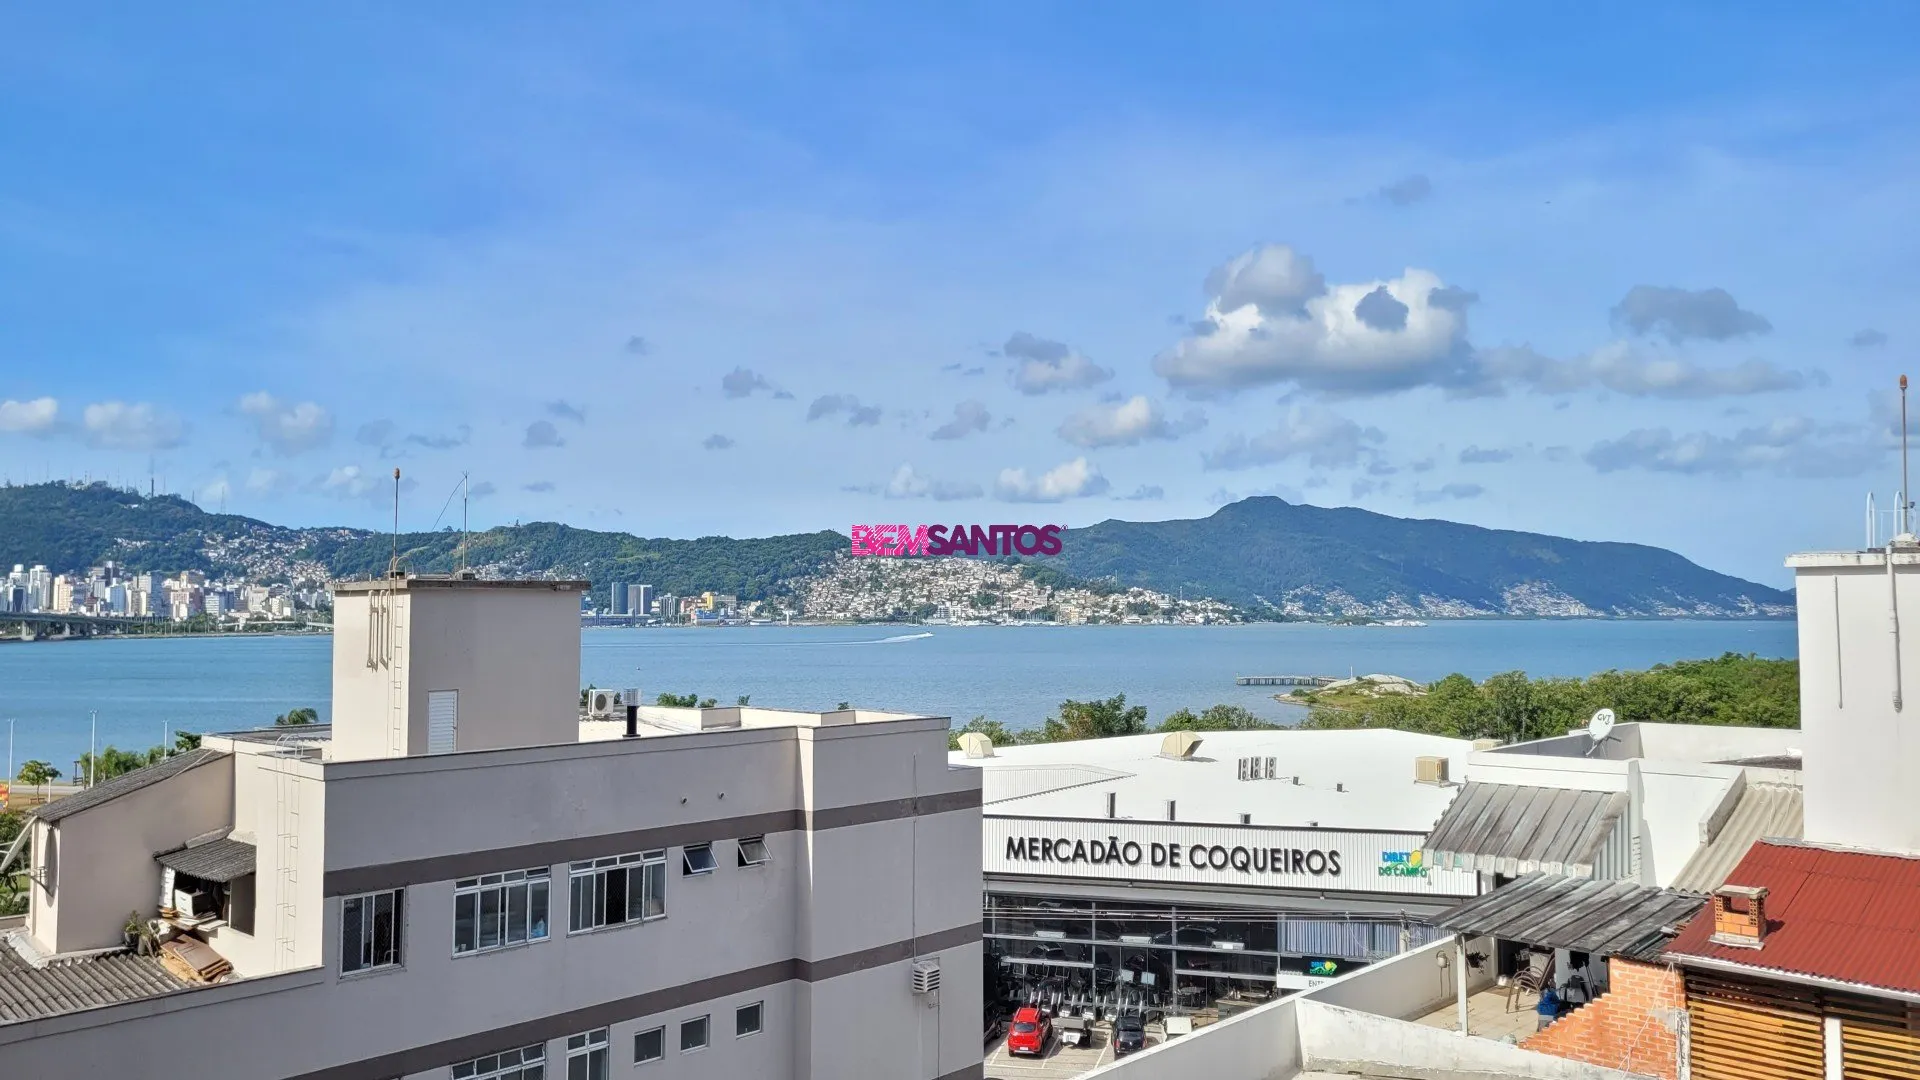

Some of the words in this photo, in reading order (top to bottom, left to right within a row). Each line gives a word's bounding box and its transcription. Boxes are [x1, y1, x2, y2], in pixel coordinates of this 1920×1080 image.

[1005, 836, 1142, 866] MERCADÃO
[1151, 842, 1181, 867] DE
[1189, 844, 1341, 876] COQUEIROS
[1378, 866, 1392, 876] DO
[1394, 867, 1427, 878] CAMPO
